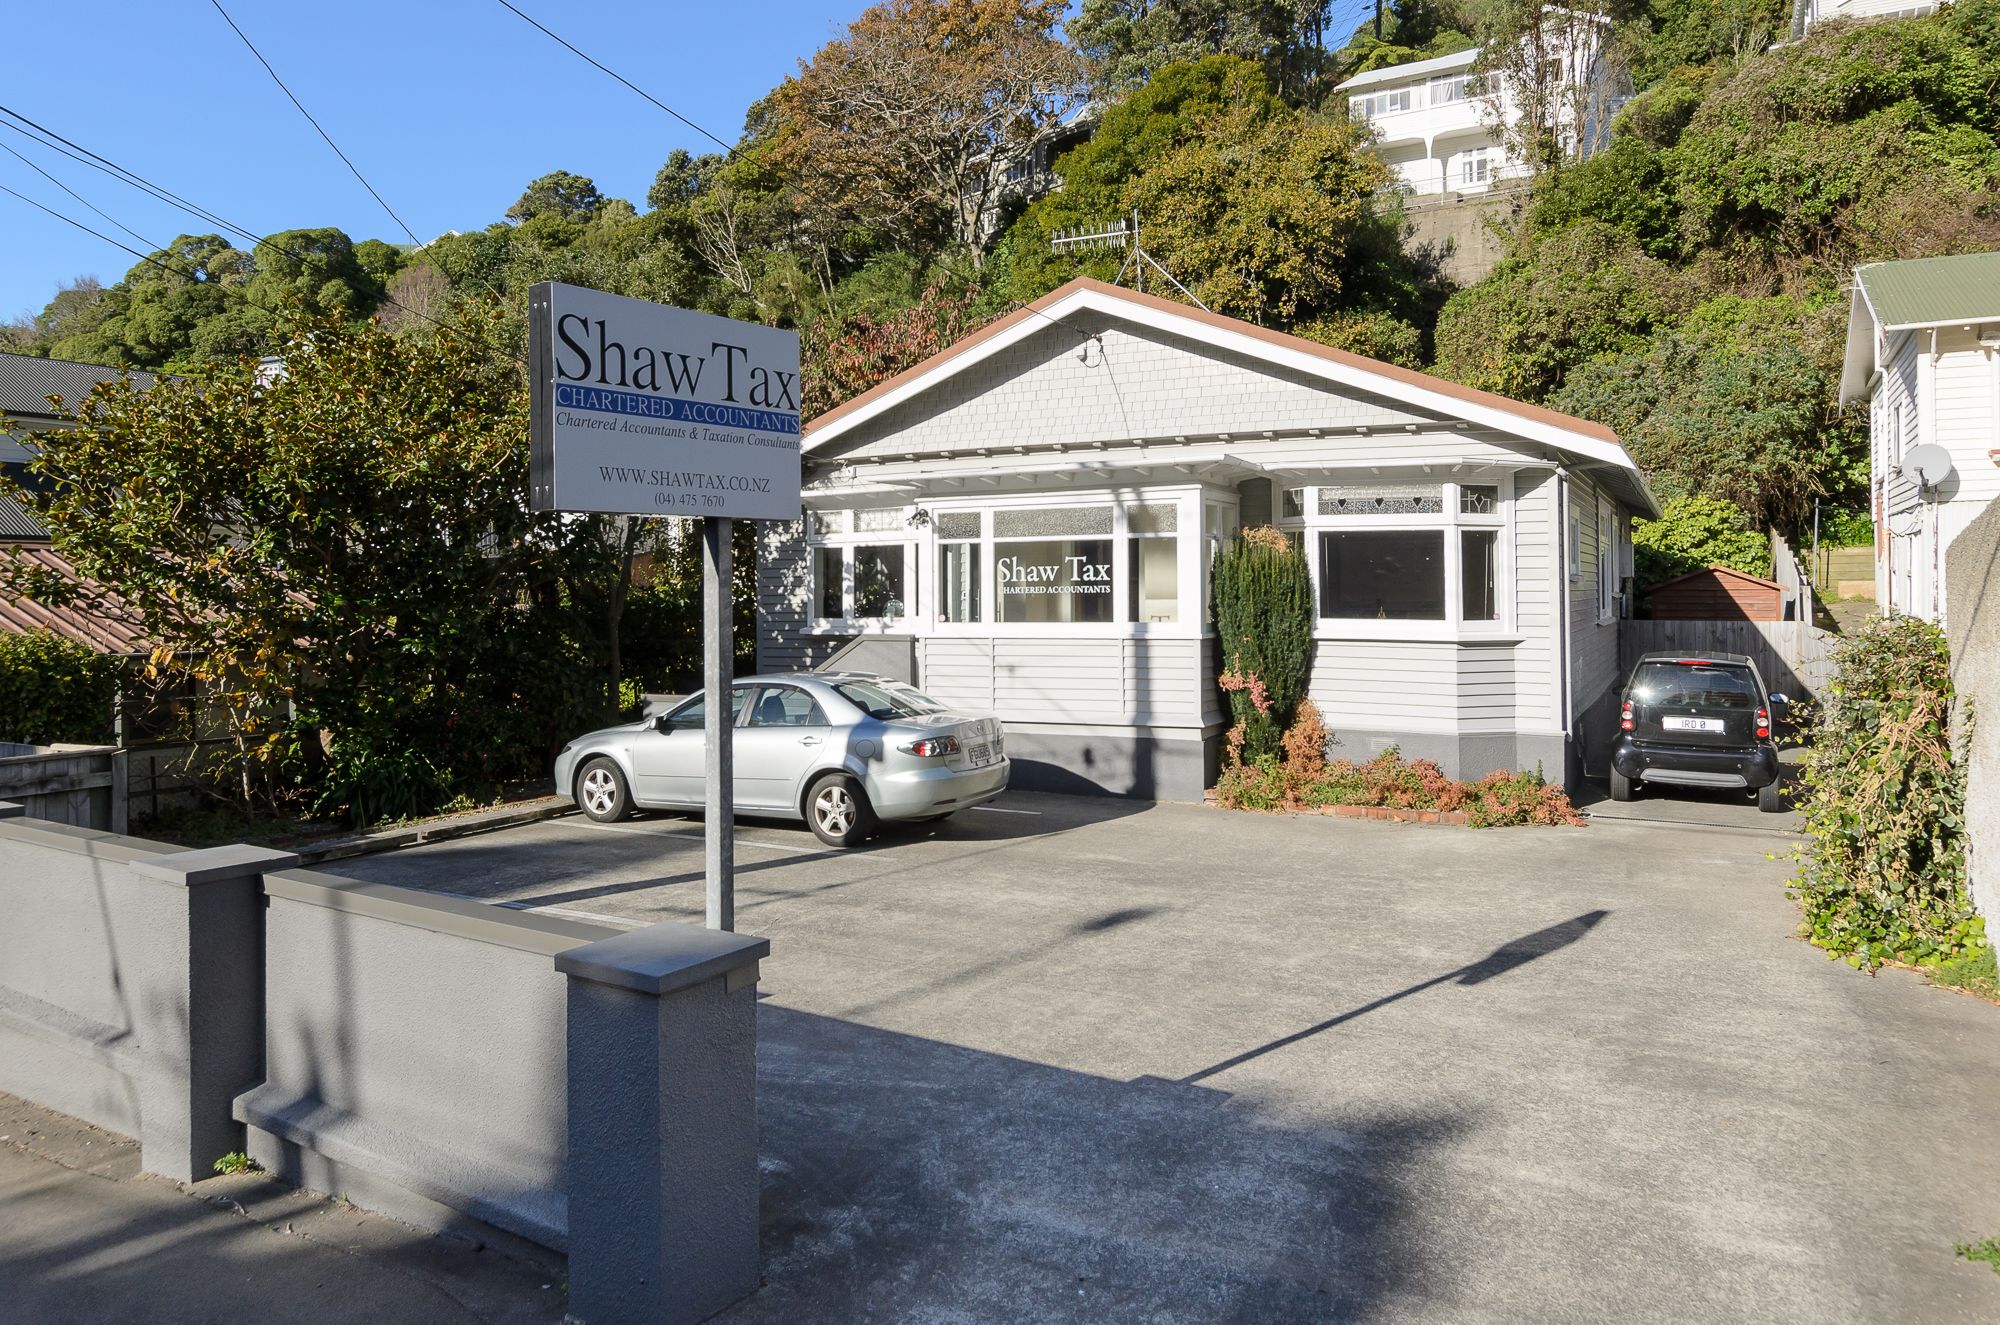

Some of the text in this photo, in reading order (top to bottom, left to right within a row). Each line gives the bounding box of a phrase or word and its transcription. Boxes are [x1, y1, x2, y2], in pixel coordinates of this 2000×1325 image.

[556, 313, 799, 411] Shaw Tax
[557, 386, 799, 433] CHARTERED ACCOUNTANTS
[556, 411, 800, 450] Chartered Accountants & Taxation Consultants
[599, 466, 771, 494] WWW.SHAWTAX.CO.NZ
[654, 492, 725, 508] (04) 475 7670
[997, 556, 1111, 582] Shaw Tax
[998, 585, 1111, 595] HARTERED ACCOUNTANTS
